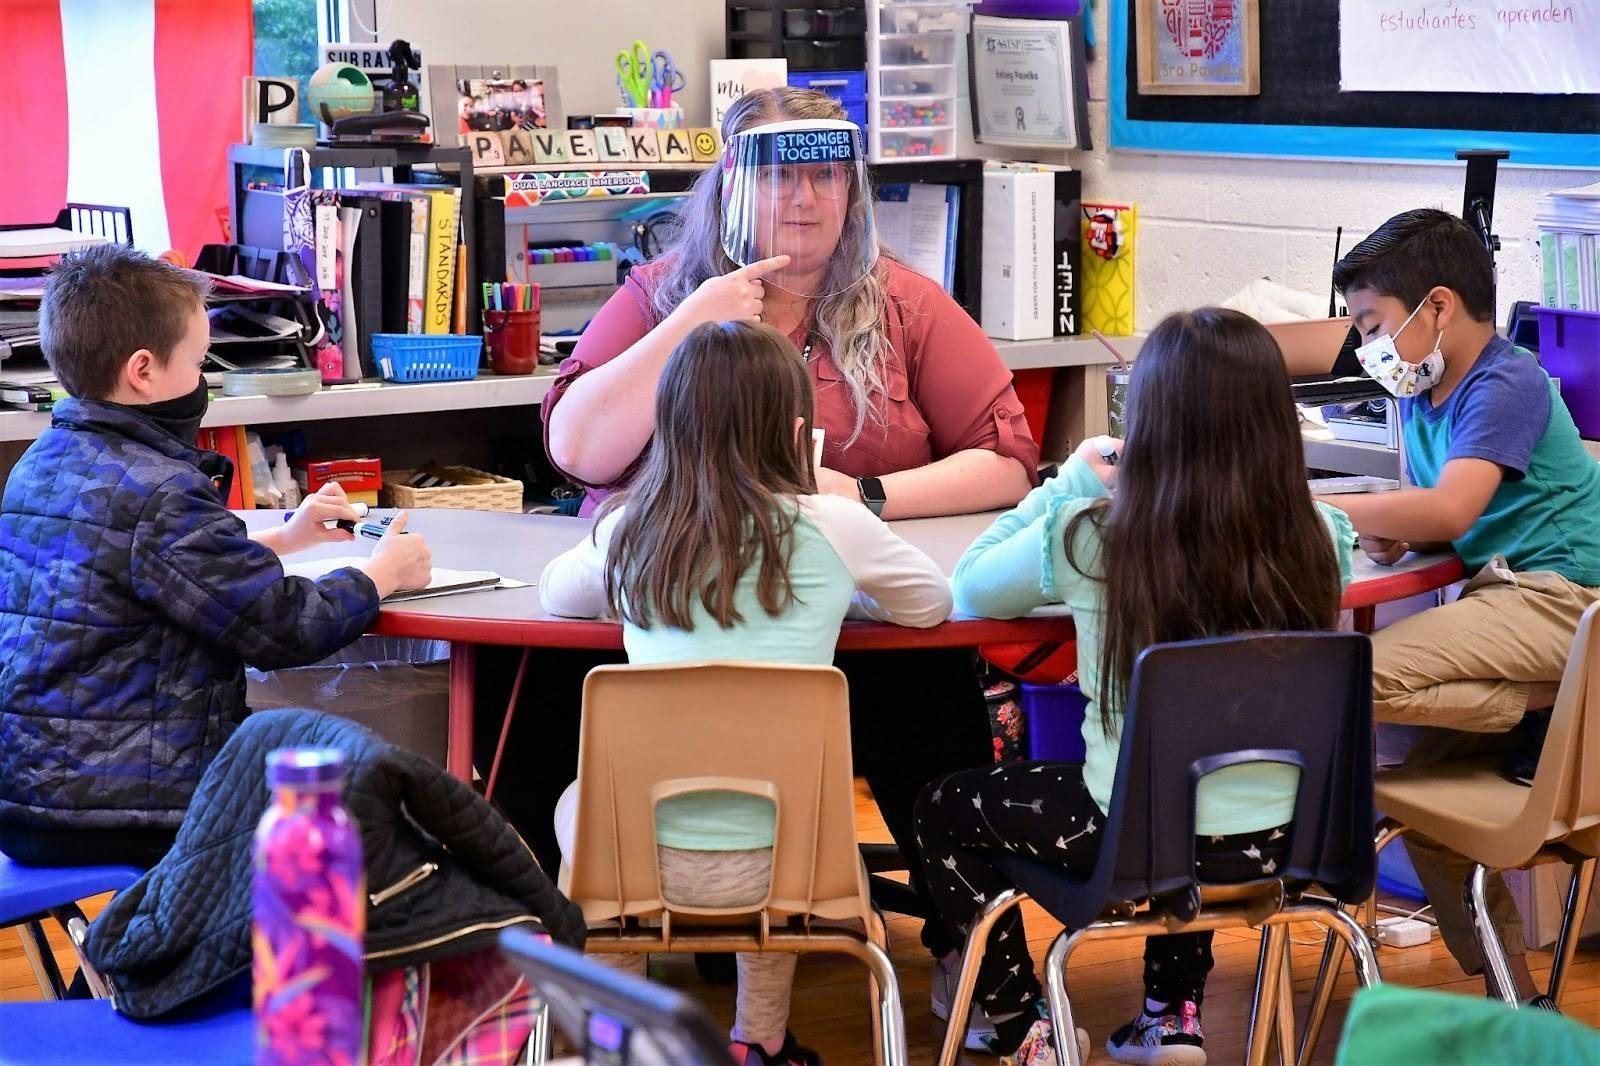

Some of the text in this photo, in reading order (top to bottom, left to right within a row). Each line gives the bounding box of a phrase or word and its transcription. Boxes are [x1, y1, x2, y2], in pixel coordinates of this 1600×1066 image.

[1380, 0, 1574, 32] estudiantes aprenden
[717, 80, 746, 98] my
[258, 80, 295, 123] P
[476, 133, 684, 158] PAVELKA
[777, 131, 849, 147] STRONGER
[778, 145, 851, 160] TOGETHER
[513, 177, 641, 190] DUAL LANGUAGE IMMERSION
[435, 218, 452, 326] STANDARDS
